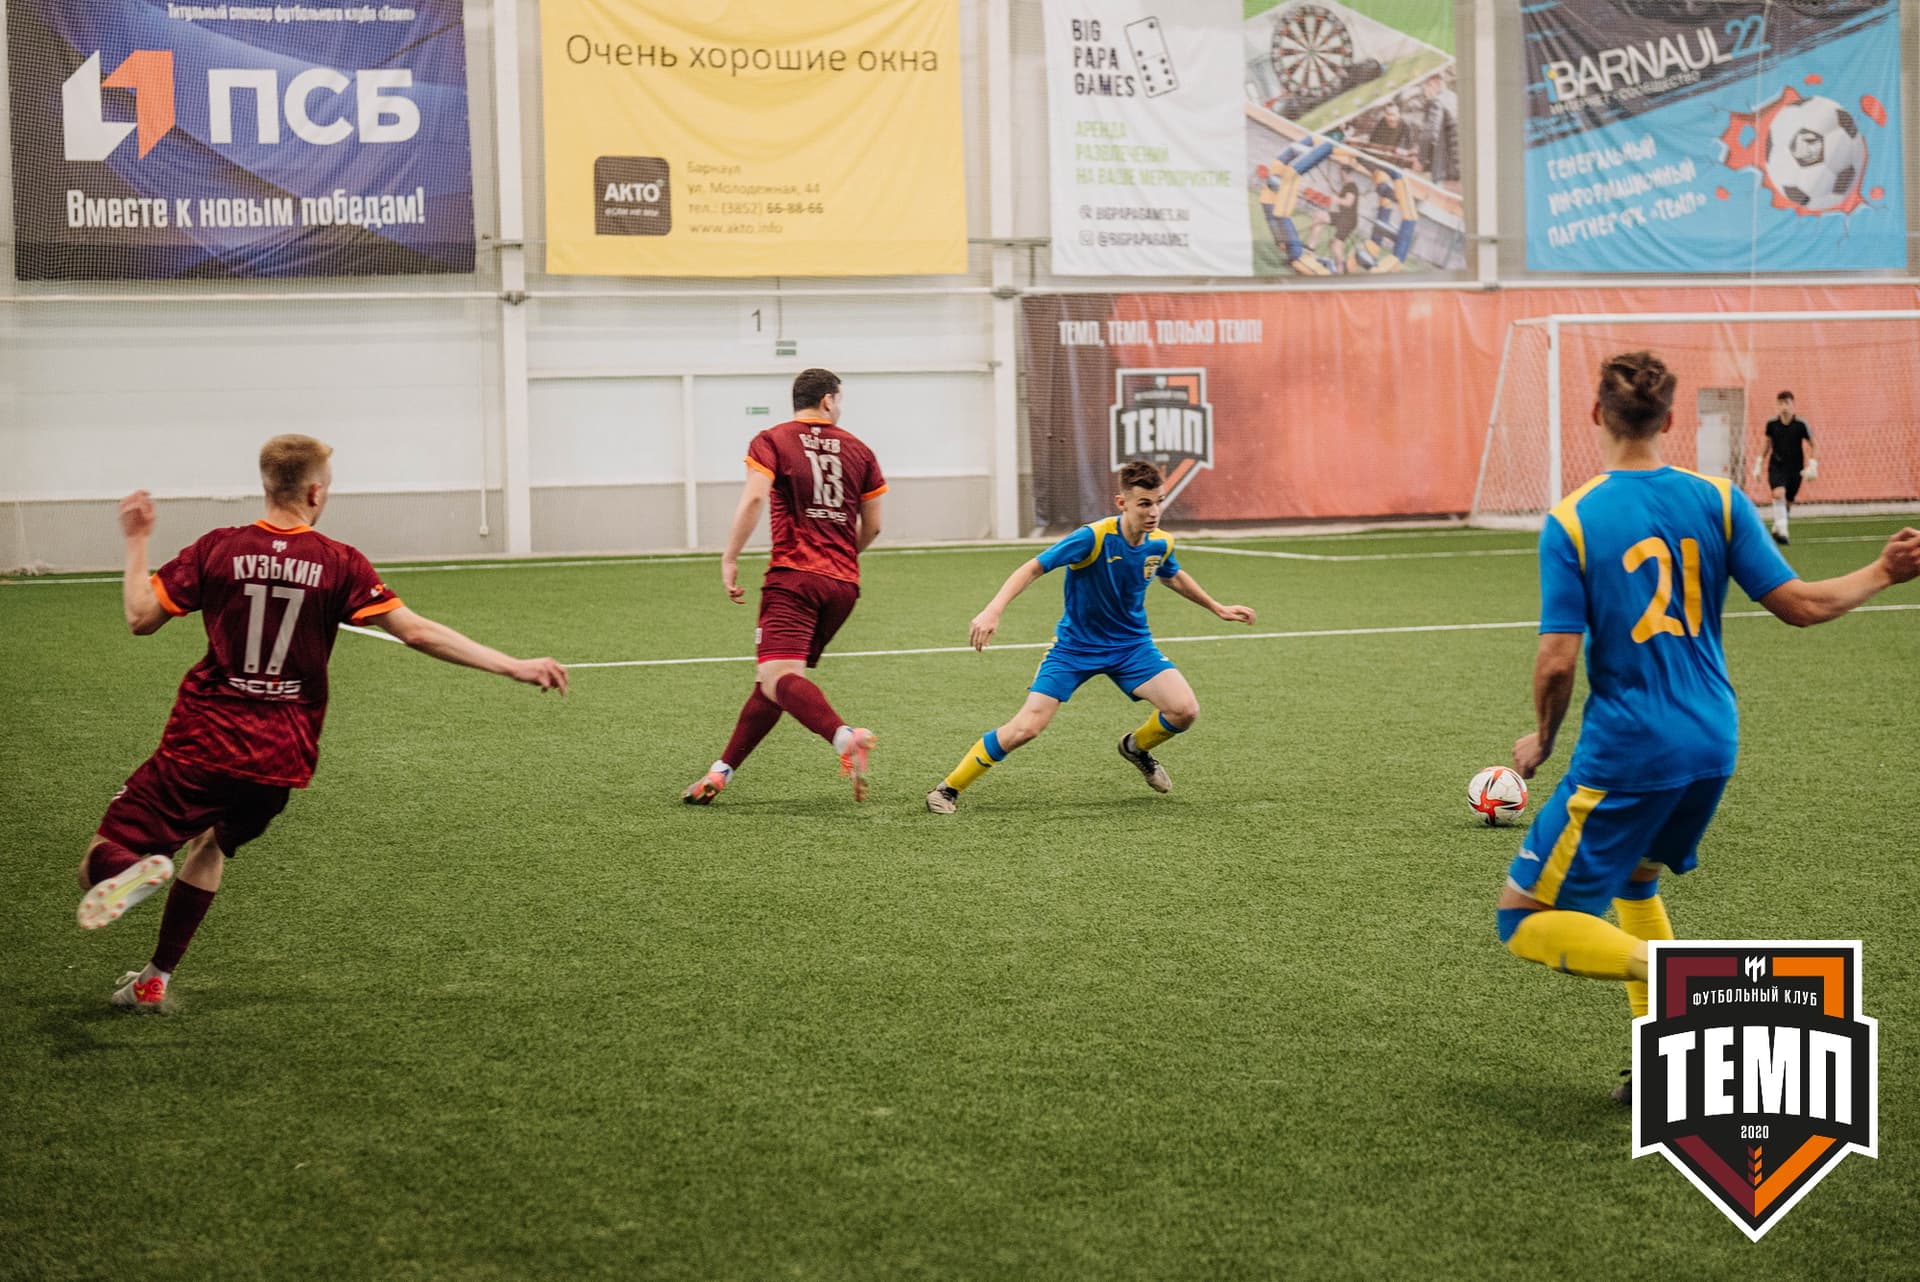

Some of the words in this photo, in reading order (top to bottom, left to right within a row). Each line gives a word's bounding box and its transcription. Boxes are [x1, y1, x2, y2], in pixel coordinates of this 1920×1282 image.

[1072, 19, 1101, 41] BIG
[566, 35, 677, 68] Очень
[689, 47, 847, 76] хорошие
[858, 50, 938, 72] окна
[1074, 46, 1119, 69] PAPA
[1074, 73, 1135, 97] GAMES
[208, 68, 421, 145] ПСБ
[687, 162, 742, 175] Барнаул
[1547, 134, 1657, 181] ГЕНЕРАЛЬНЫЙ
[804, 183, 820, 193] 44
[66, 189, 168, 228] Вместе
[176, 199, 192, 227] к
[199, 198, 293, 228] новым
[301, 186, 425, 229] победам!
[766, 203, 824, 214] 66-88-66
[1548, 212, 1617, 248] ПАРТНЕР
[752, 309, 761, 332] 1
[1058, 321, 1105, 347] ТЕМП,
[1155, 319, 1215, 345] ТОЛЬКО
[1218, 319, 1263, 345] ТЕМП!
[1121, 408, 1202, 456] ТЕМП
[804, 450, 844, 508] 13
[233, 554, 324, 588] КУЗЬКИН
[1622, 537, 1702, 644] 21
[243, 584, 305, 675] 17
